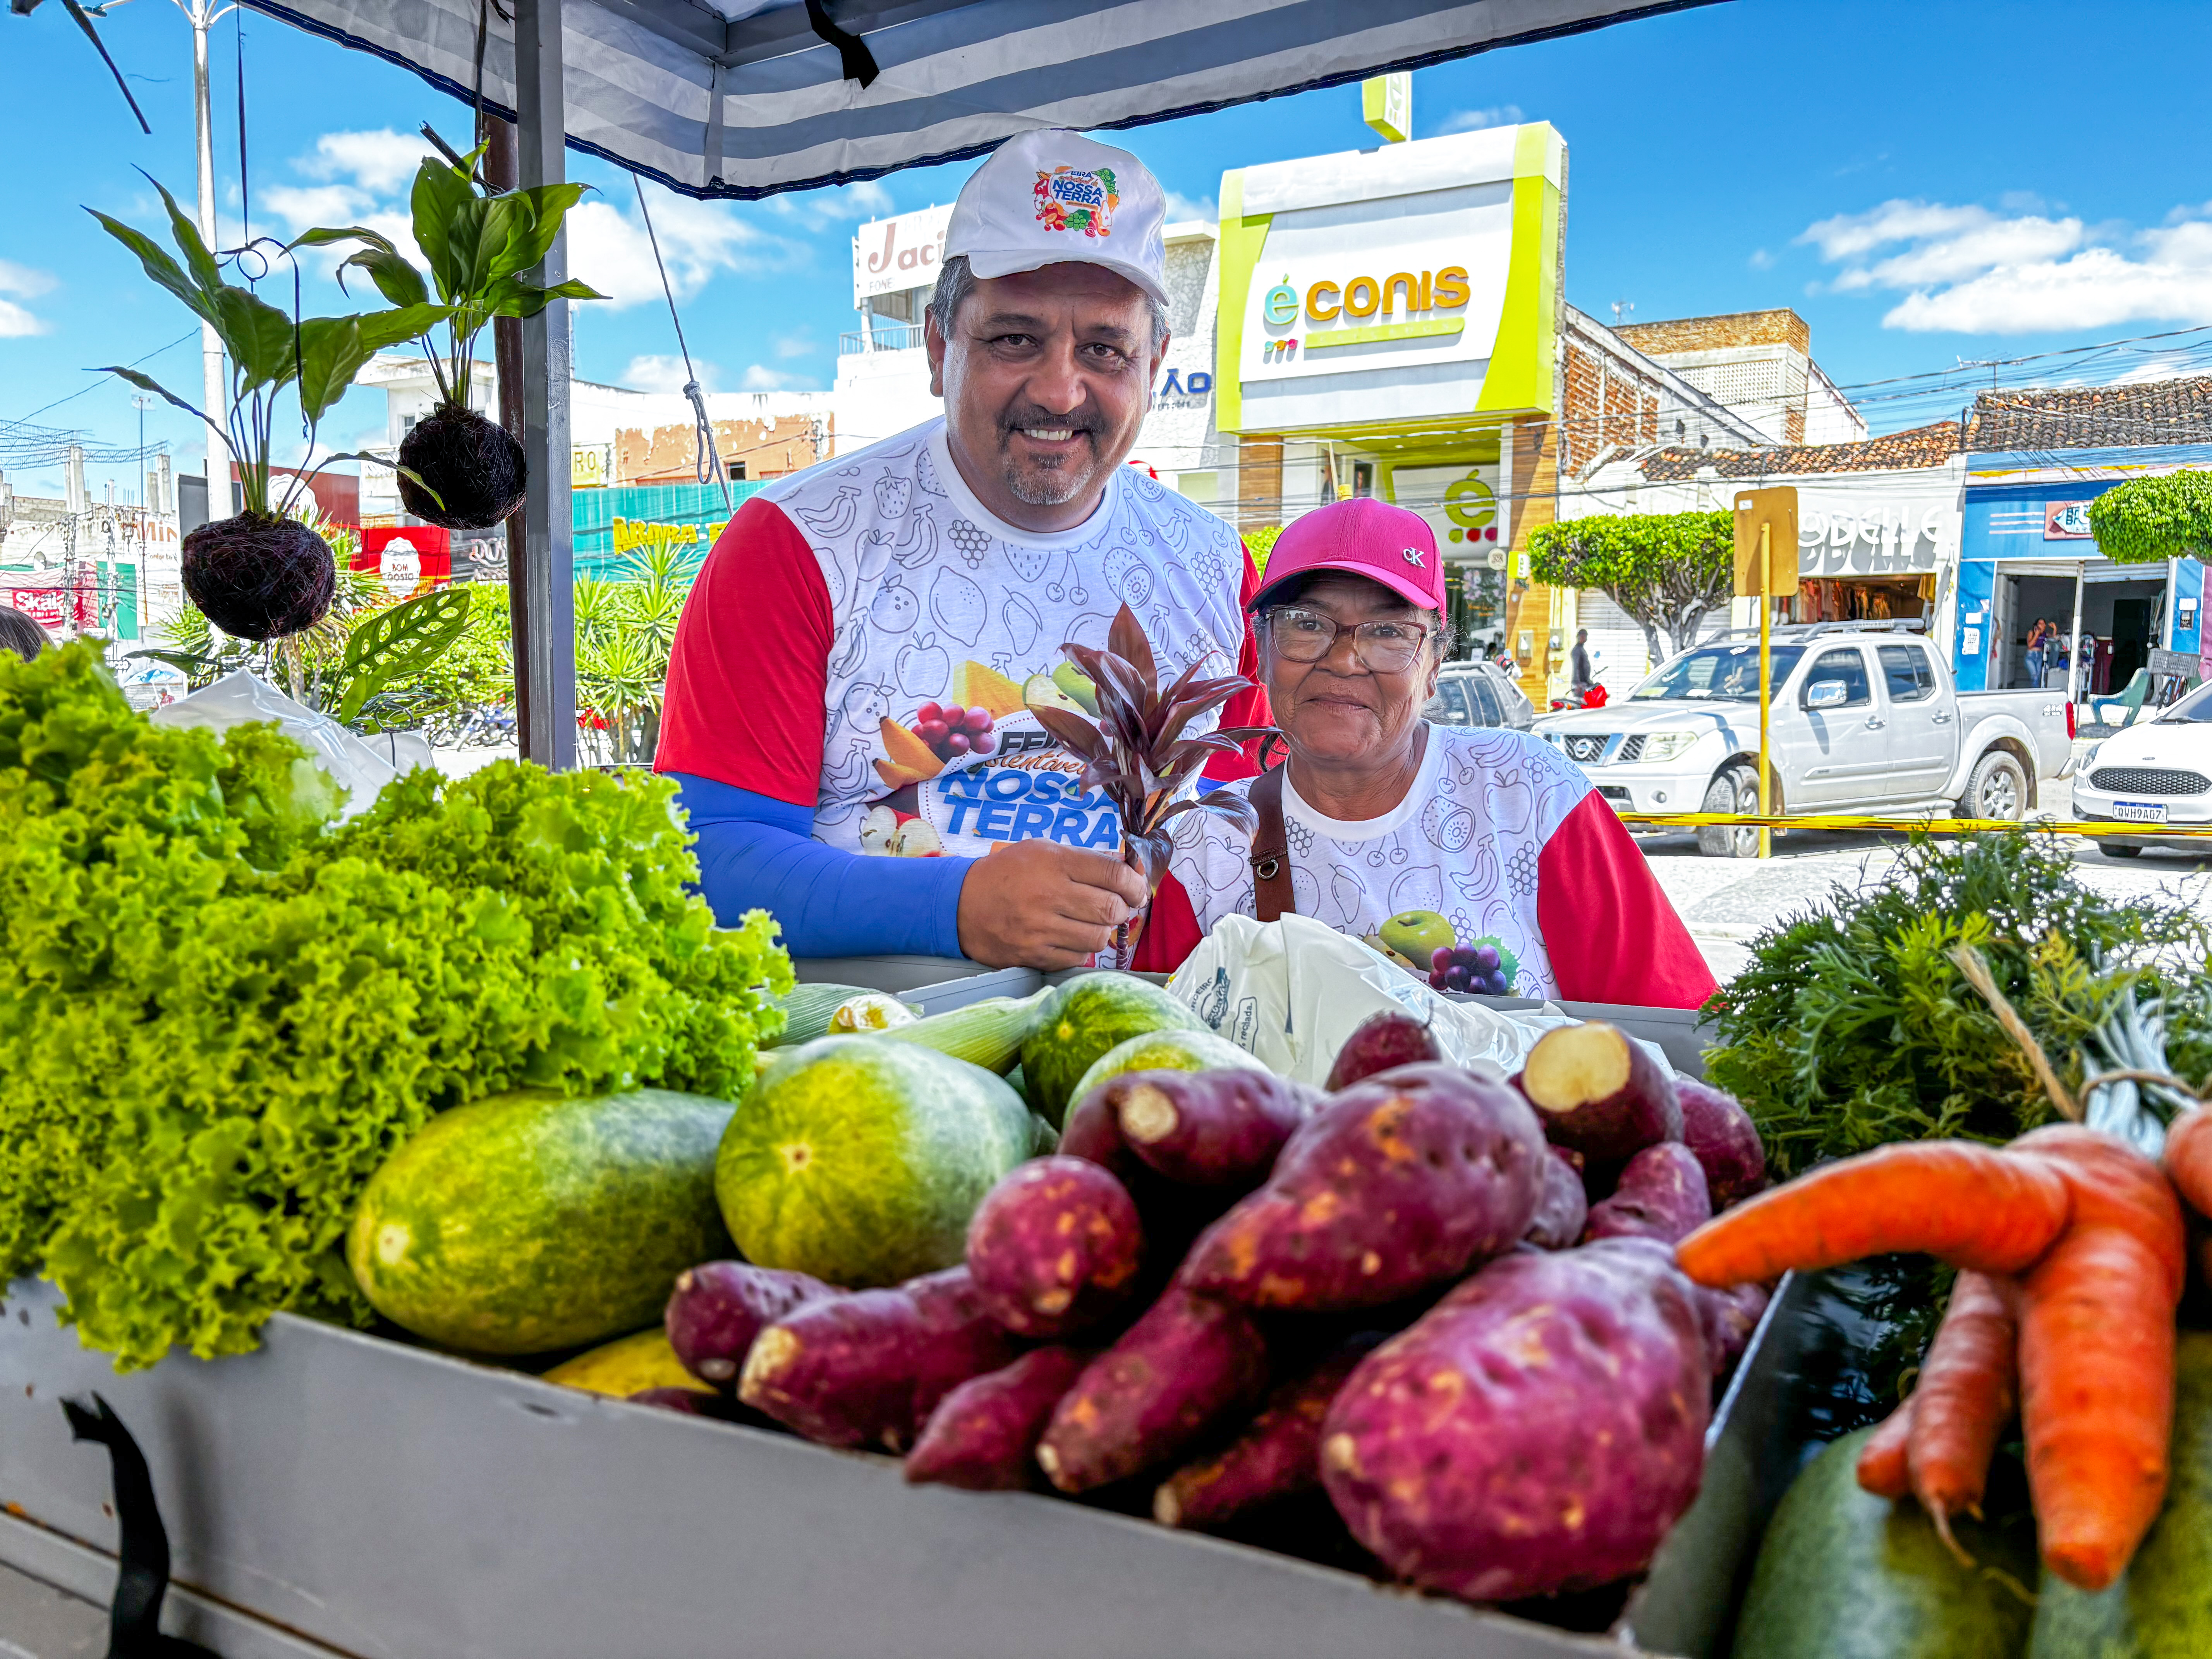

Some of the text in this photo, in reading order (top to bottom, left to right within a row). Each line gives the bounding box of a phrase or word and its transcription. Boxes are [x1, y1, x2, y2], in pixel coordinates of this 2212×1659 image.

[1053, 180, 1103, 198] NOSSA
[1054, 189, 1101, 207] TERRA
[1152, 368, 1211, 397] ÃO
[943, 794, 1119, 849] TERRA
